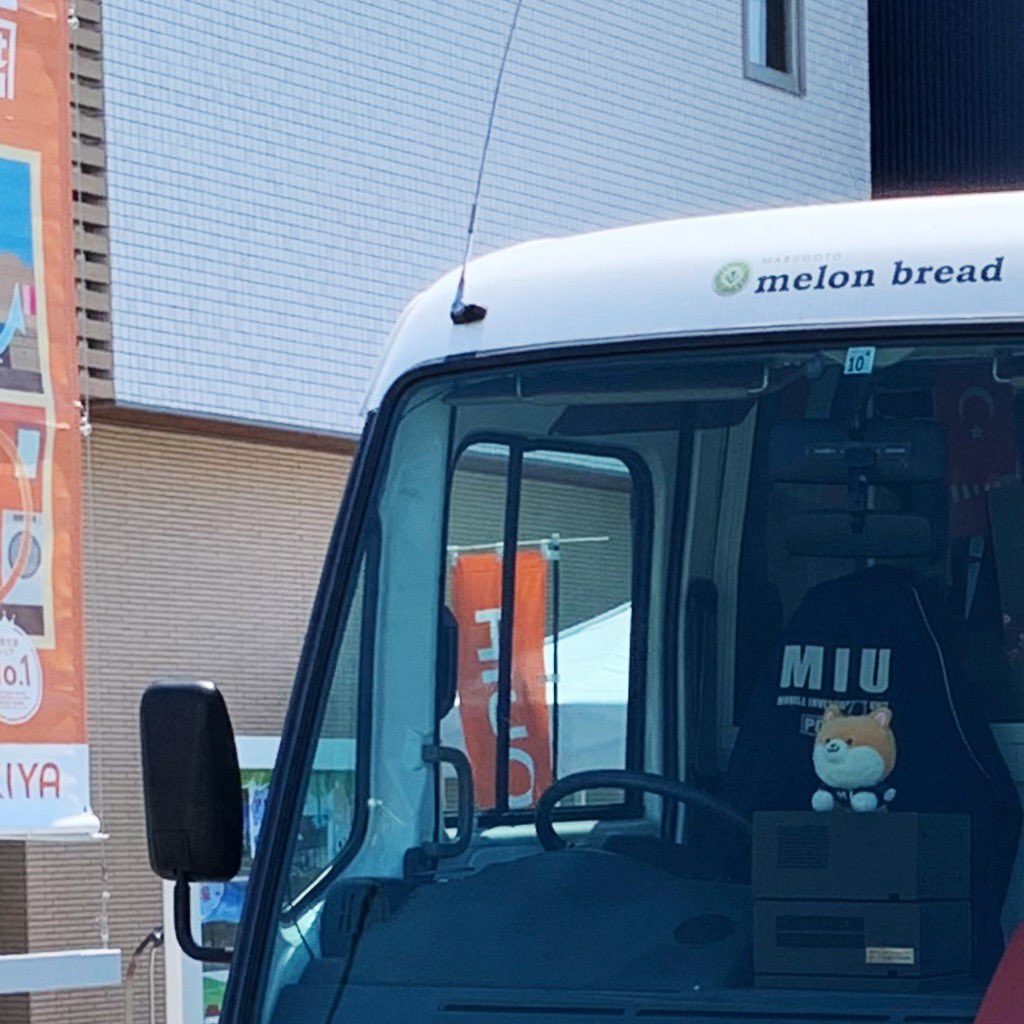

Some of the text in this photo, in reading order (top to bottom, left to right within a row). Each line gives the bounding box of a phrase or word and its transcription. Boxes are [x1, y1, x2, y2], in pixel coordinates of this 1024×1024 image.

[754, 256, 1004, 293] melon bread
[0, 655, 30, 687] o.1
[780, 645, 891, 693] MIU
[0, 762, 60, 799] IYA
